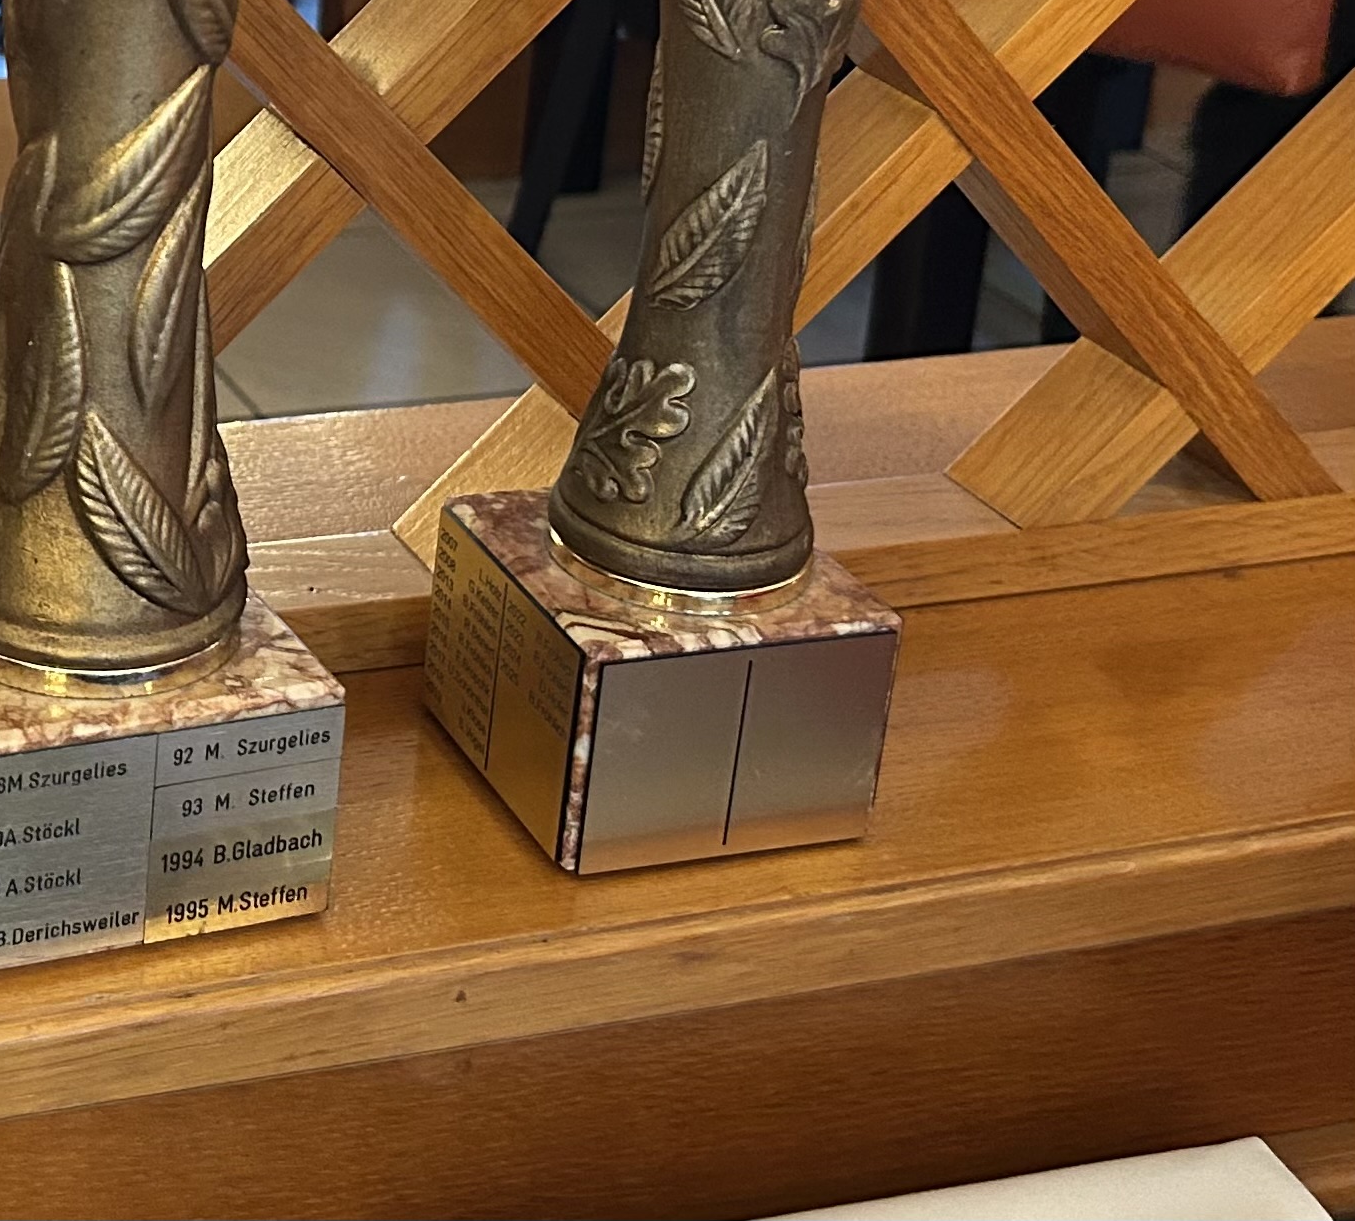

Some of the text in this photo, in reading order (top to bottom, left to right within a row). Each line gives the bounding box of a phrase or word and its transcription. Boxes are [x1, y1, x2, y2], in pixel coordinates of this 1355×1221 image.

[173, 729, 331, 767] 92 M. Szurgelies
[182, 782, 316, 818] 93 M. Steffen
[161, 828, 323, 874] 1994 B.Gladbach
[165, 897, 209, 925] 1995
